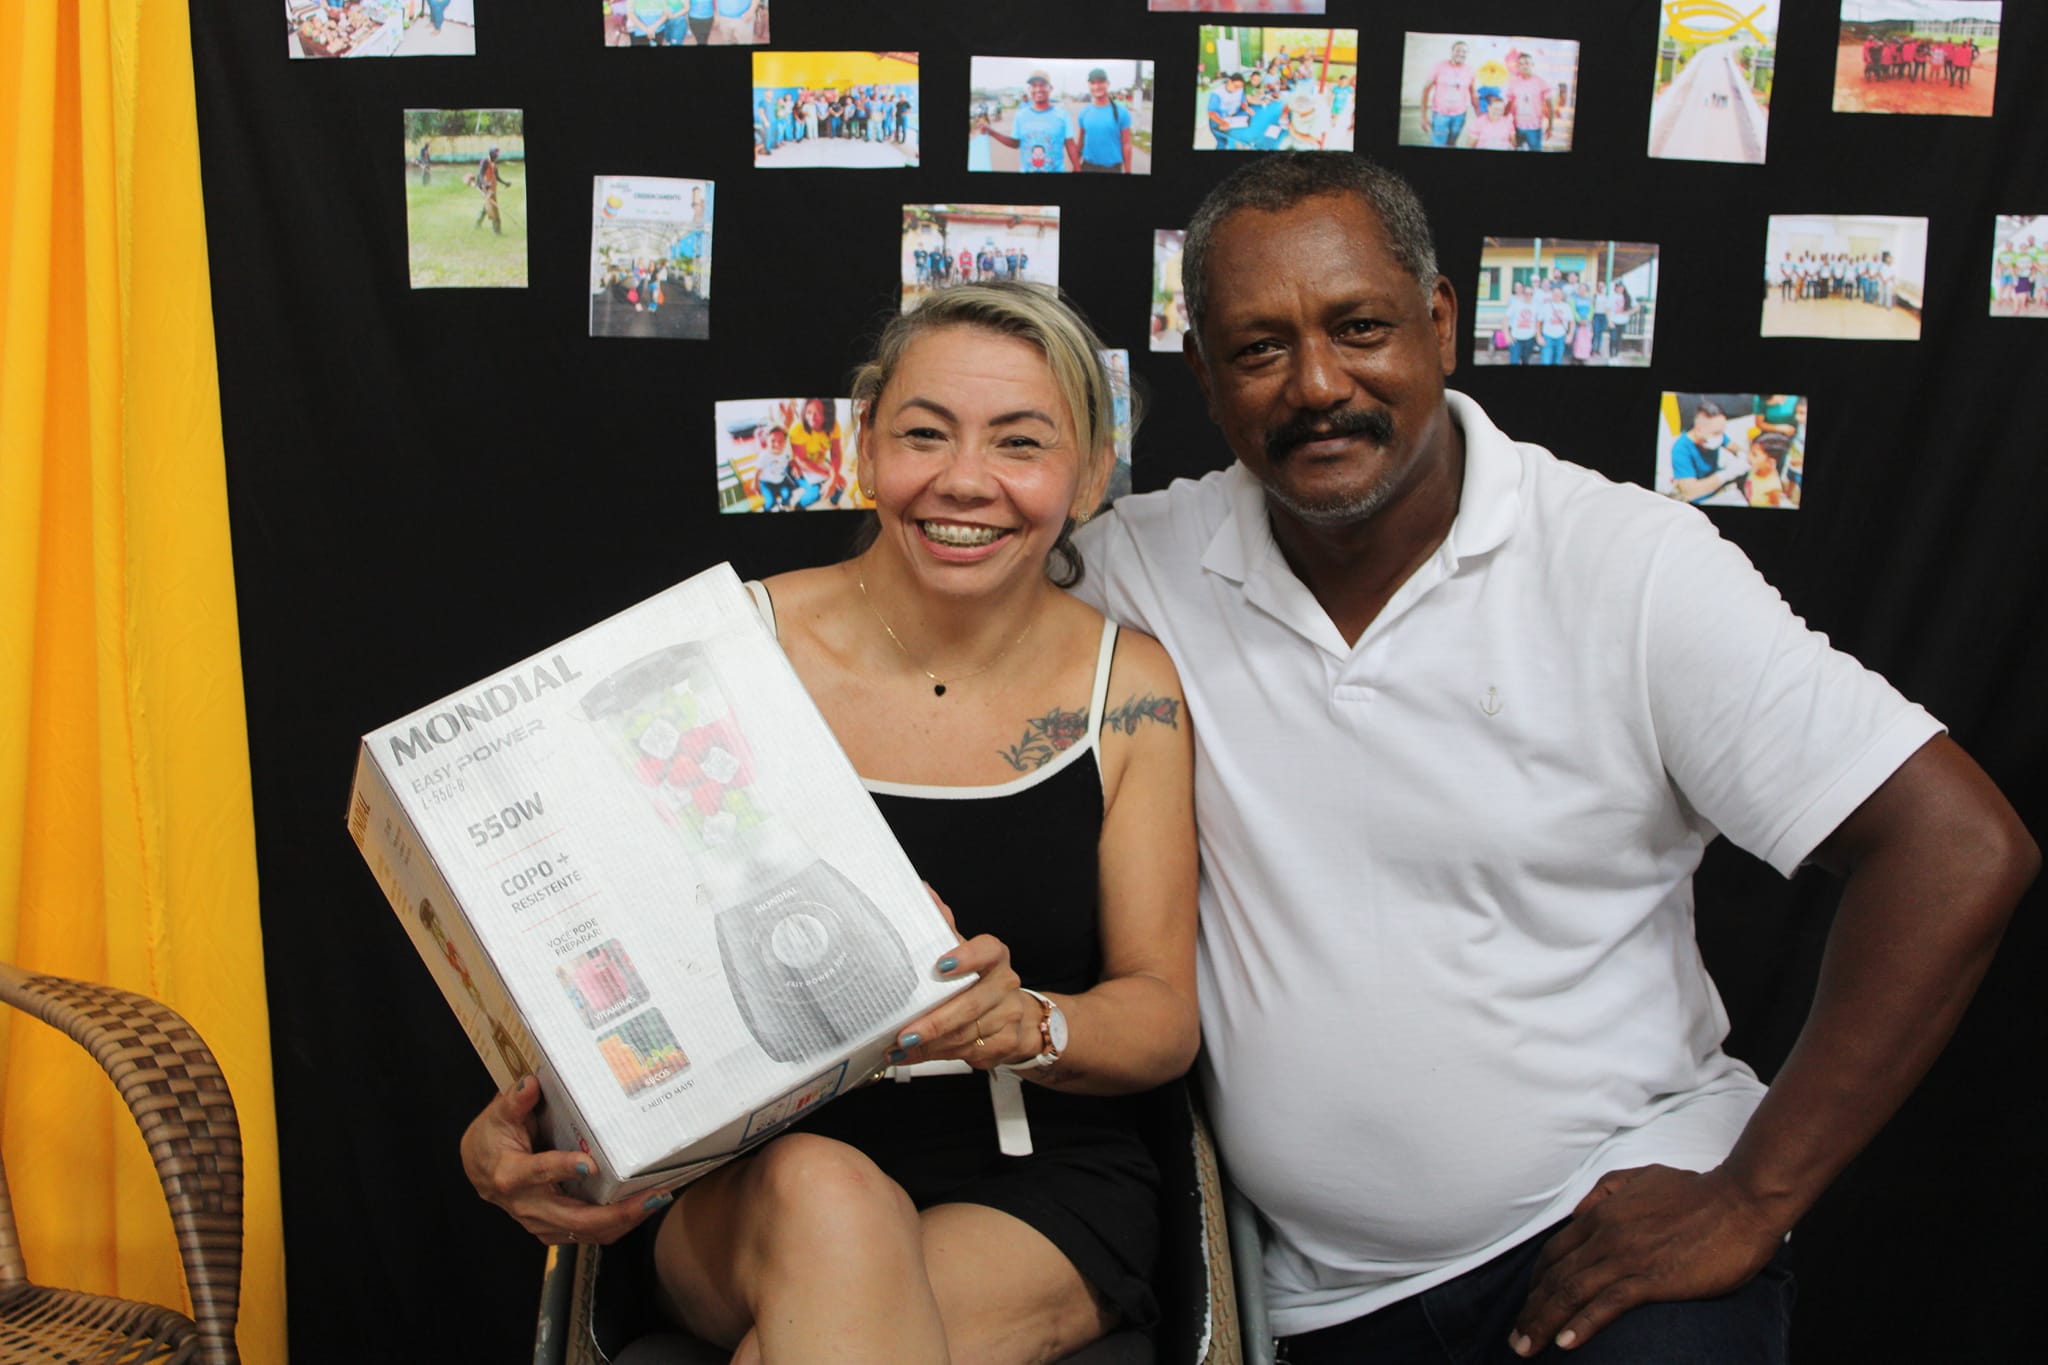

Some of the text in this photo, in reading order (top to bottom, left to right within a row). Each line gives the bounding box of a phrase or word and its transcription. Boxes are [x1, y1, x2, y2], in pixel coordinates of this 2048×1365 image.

[389, 654, 582, 767] MONDIAL
[411, 718, 547, 794] EASY POWER
[467, 791, 544, 847] 550W
[500, 860, 554, 897] COPO
[511, 870, 582, 913] RESISTENTE
[572, 917, 599, 936] PODE
[644, 1067, 671, 1087] SUCOS
[648, 1093, 674, 1110] MUITO
